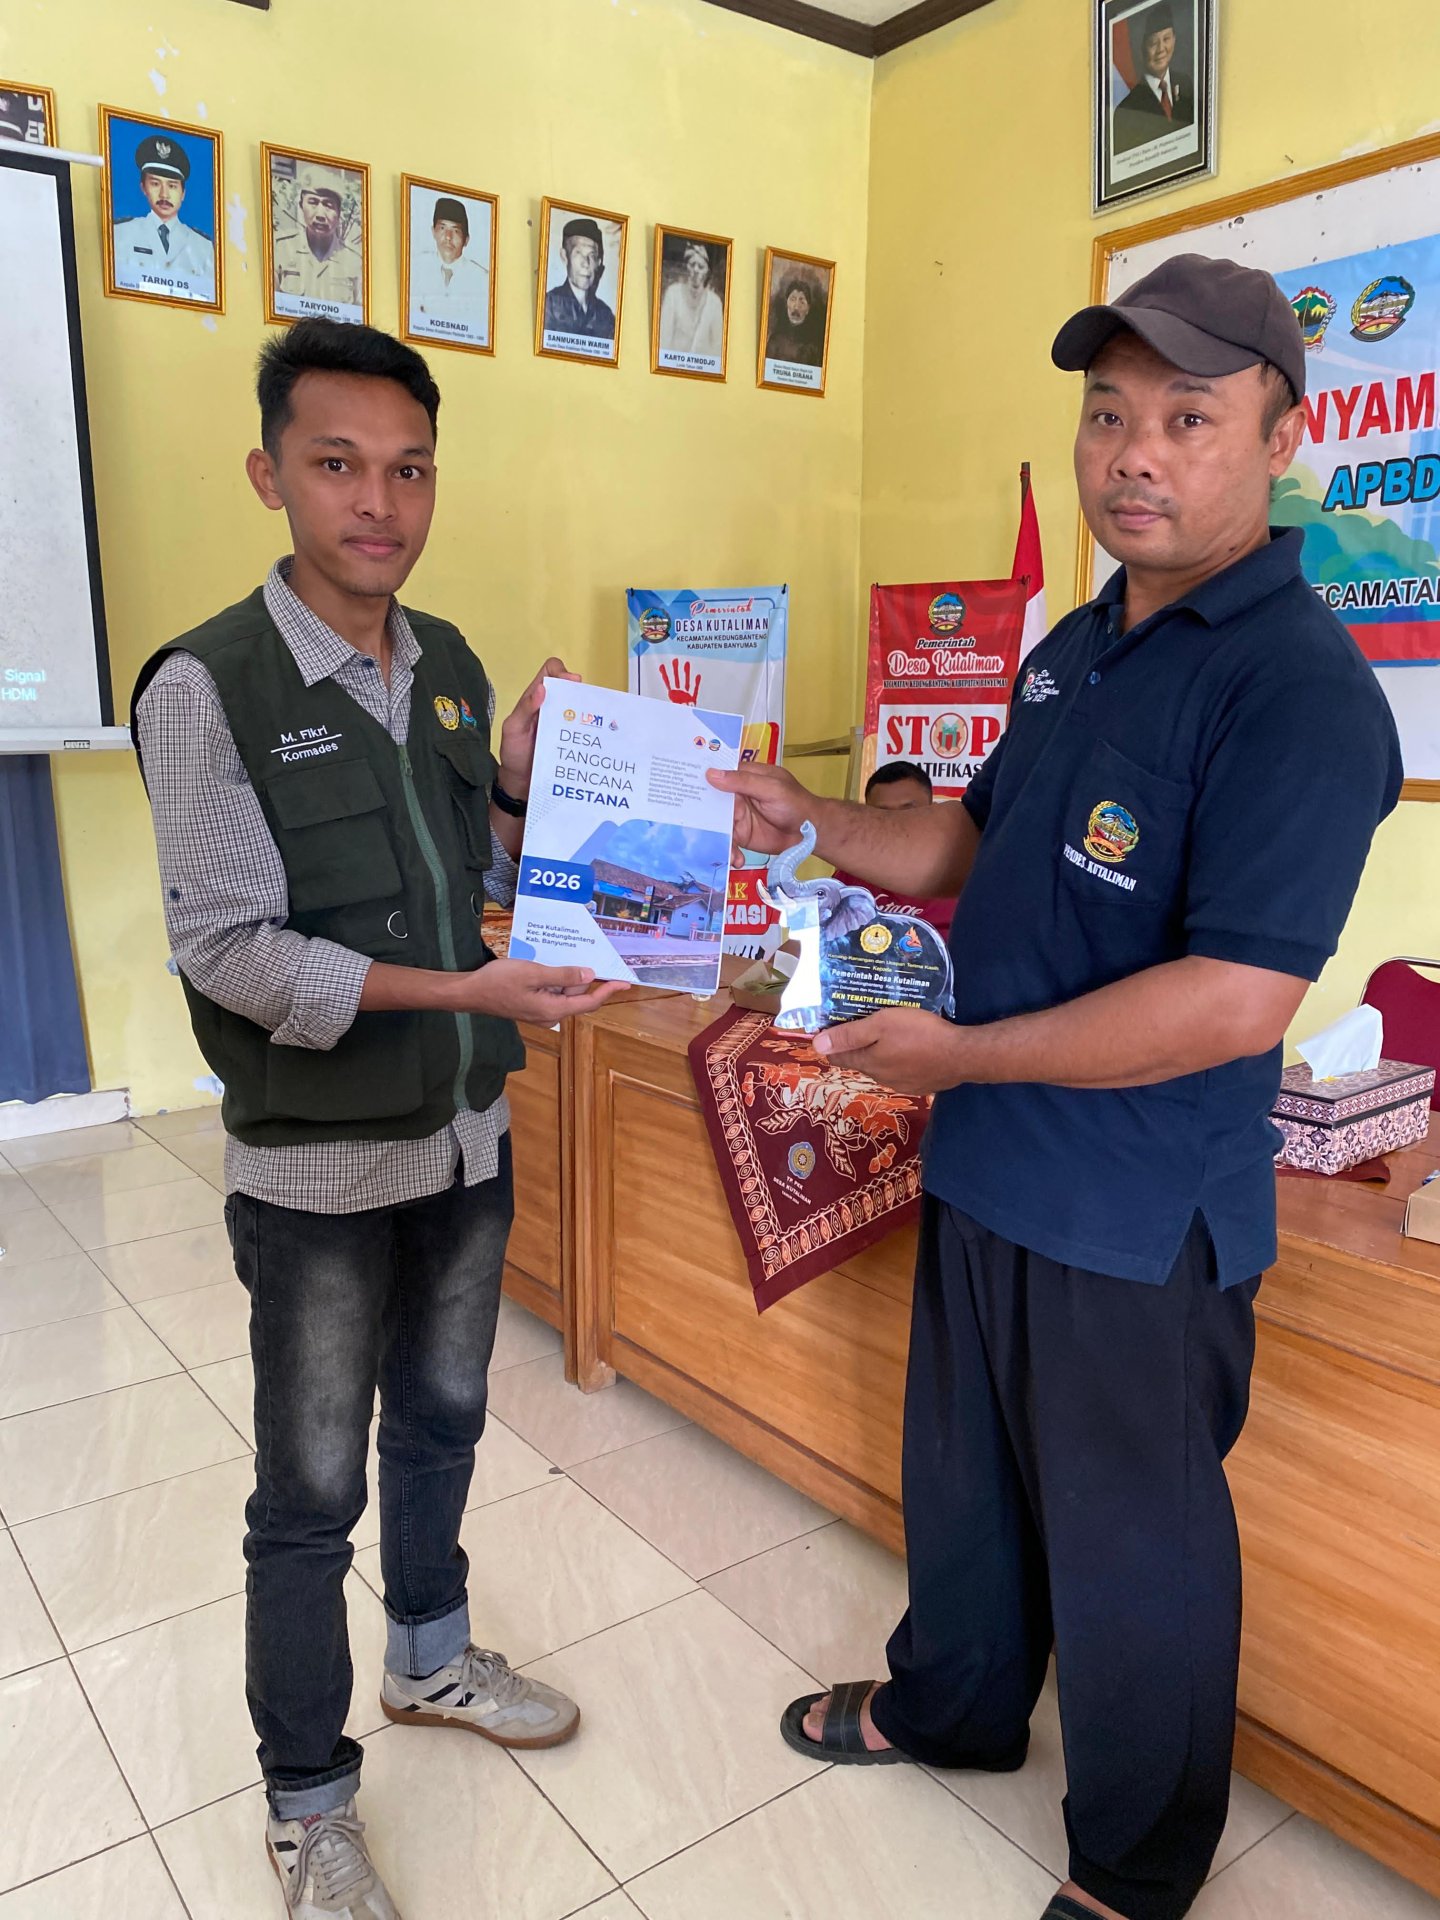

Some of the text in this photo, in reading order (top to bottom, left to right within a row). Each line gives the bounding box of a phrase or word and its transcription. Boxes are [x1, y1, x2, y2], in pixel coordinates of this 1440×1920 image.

[141, 274, 174, 287] TARNO
[176, 280, 190, 290] DS
[300, 300, 340, 314] TARYONO
[430, 319, 469, 332] KOESNADI
[547, 334, 587, 346] SANMUKSIN
[588, 340, 610, 350] WARIM
[664, 353, 716, 366] KARTO ATMODJO
[675, 618, 769, 632] DESA KUTALIMAN
[676, 633, 768, 642] KECAMATAN KEDUNGBANTENG
[916, 637, 976, 650] Pemerintah
[888, 650, 1004, 676] Desa Kutaliman
[4, 669, 46, 684] Signal
[1, 687, 37, 701] HDMI
[280, 732, 298, 744] M.
[559, 729, 602, 749] DESA
[281, 742, 339, 763] Kormades
[557, 746, 636, 775] TANGGUH
[554, 765, 634, 792] BENCANA
[552, 784, 630, 809] DESTANA
[528, 868, 581, 890] 2026
[1086, 861, 1137, 892] KUTALIMAN
[545, 924, 580, 934] Kutaliman
[526, 936, 577, 948] Kab. Banyumas
[542, 931, 596, 945] Kedungbanteng
[831, 968, 930, 988] Pemerintah Desa Kutaliman
[846, 994, 874, 1003] TEMATIK
